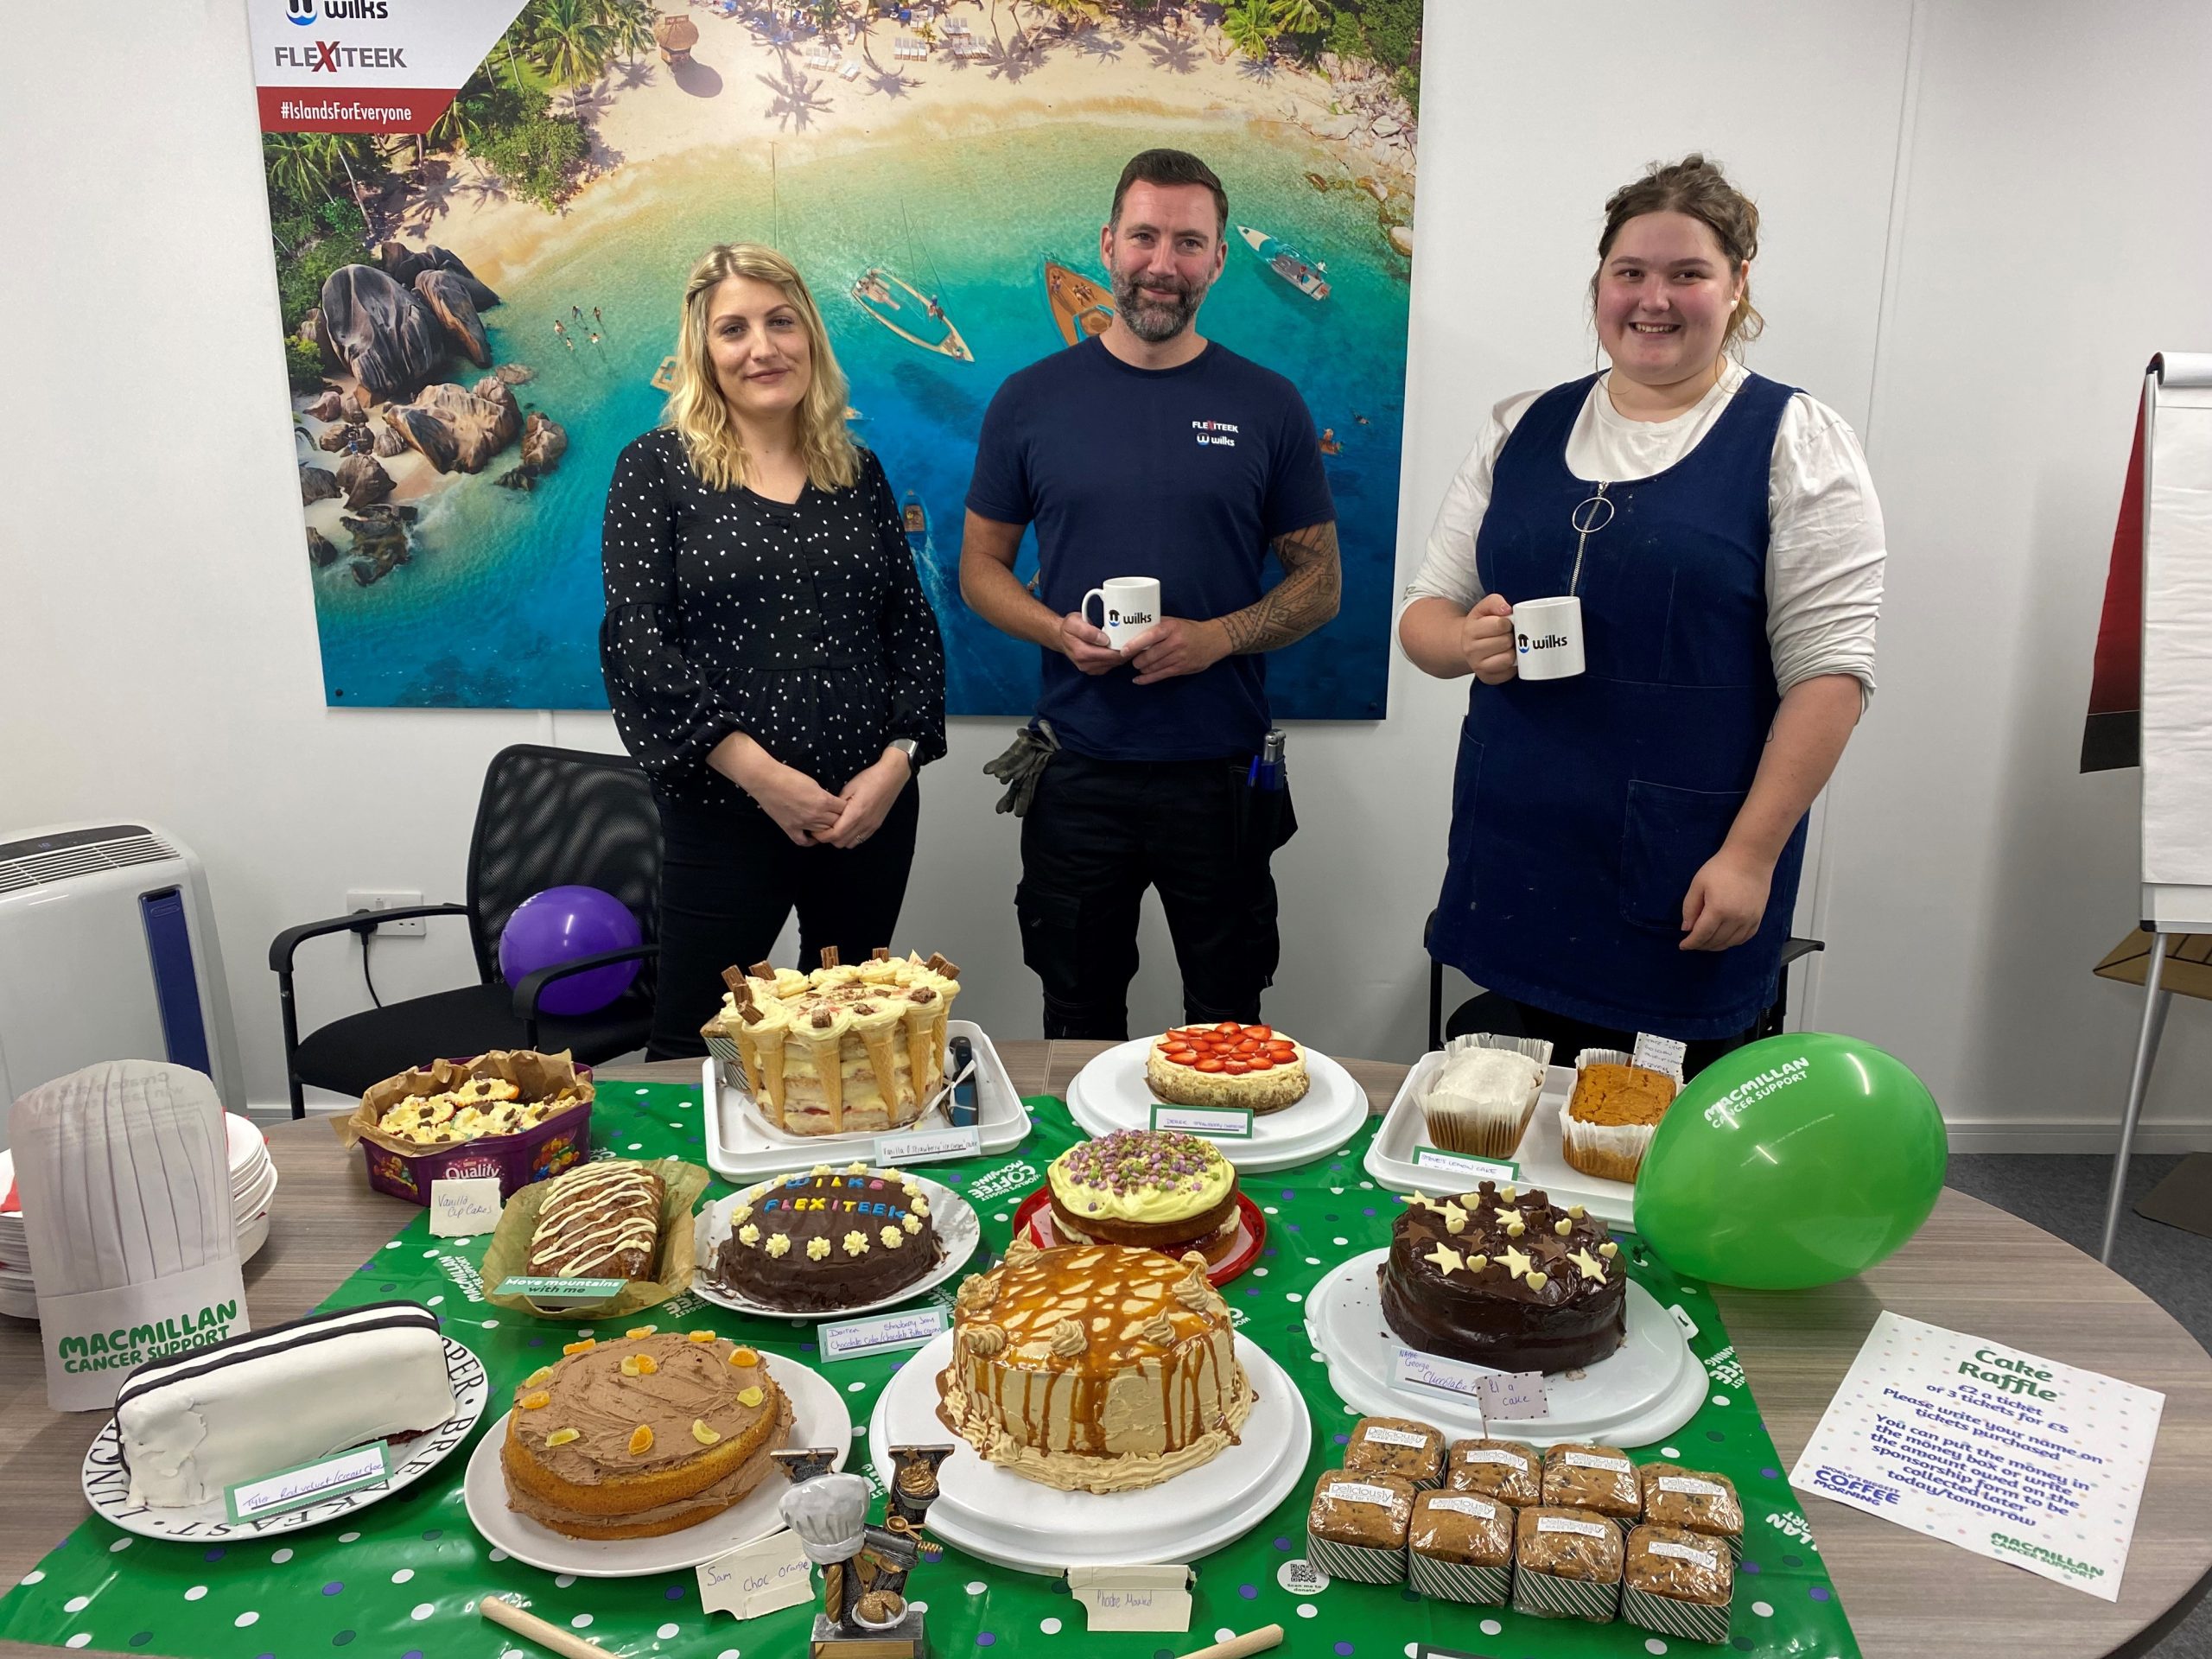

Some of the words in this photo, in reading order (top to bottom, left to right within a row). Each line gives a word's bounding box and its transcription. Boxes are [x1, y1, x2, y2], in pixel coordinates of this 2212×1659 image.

[274, 41, 407, 73] FLEXITEEK
[281, 101, 412, 124] #IslandsForEveryone
[1192, 420, 1239, 433] FLEXITEEK
[1211, 435, 1235, 446] wilks
[1123, 612, 1152, 624] wilks
[1533, 634, 1567, 649] wilks
[1704, 1057, 1809, 1122] MACMILLAN
[1713, 1096, 1756, 1128] CANCER
[1755, 1070, 1808, 1100] SUPPORT
[446, 1164, 499, 1180] Quality
[968, 1165, 1035, 1198] COFFEE
[438, 1193, 468, 1207] Vanilla
[764, 1198, 906, 1220] FLEXITEEK
[546, 1279, 620, 1287] mountains
[59, 1300, 237, 1360] MACMILLAN
[64, 1350, 143, 1374] CANCER
[147, 1325, 230, 1361] SUPPORT
[1399, 1350, 1419, 1358] NAME
[1405, 1358, 1430, 1372] George
[1958, 1361, 2058, 1403] Raffle
[1975, 1350, 2053, 1382] Cake
[1926, 1384, 1946, 1395] or
[1947, 1389, 1956, 1398] 3
[1961, 1395, 2015, 1417] tickets
[2017, 1412, 2044, 1426] for
[2047, 1422, 2069, 1434] £5
[1958, 1384, 1979, 1396] £2
[1982, 1391, 1993, 1400] a
[1996, 1395, 2043, 1417] ticket
[1368, 1427, 1426, 1443] Deliciously
[1884, 1388, 1934, 1410] Please
[1937, 1407, 1982, 1426] write
[1986, 1421, 2025, 1440] your
[2029, 1436, 2077, 1457] name
[2081, 1452, 2103, 1465] on
[1915, 1407, 1970, 1431] tickets
[1972, 1427, 2061, 1461] purchased
[1567, 1453, 1628, 1469] Deliciously
[1875, 1424, 1903, 1440] the
[1905, 1435, 1962, 1461] money
[1967, 1453, 1998, 1471] box
[2001, 1468, 2022, 1478] or
[2024, 1475, 2072, 1497] write
[1877, 1414, 1906, 1431] You
[1910, 1427, 1939, 1441] can
[1942, 1438, 1973, 1452] put
[1977, 1448, 2005, 1463] the
[2008, 1459, 2068, 1486] money
[2072, 1478, 2089, 1491] in
[1662, 1478, 1722, 1493] Deliciously
[1815, 1470, 1901, 1505] COFFEE
[1821, 1465, 1862, 1481] WORLD'S
[1870, 1433, 1897, 1448] the
[1901, 1445, 1968, 1471] amount
[1970, 1469, 2018, 1489] owed
[2022, 1485, 2046, 1498] on
[2049, 1493, 2081, 1510] the
[1872, 1445, 1973, 1484] sponsorship
[1975, 1478, 2020, 1500] form
[2024, 1495, 2043, 1507] to
[2047, 1502, 2069, 1516] be
[280, 1487, 297, 1498] Red
[1331, 1484, 1392, 1502] Deliciously
[1814, 1479, 1880, 1505] MORNING
[1887, 1470, 2036, 1526] today/tomorrow
[1903, 1465, 1980, 1497] collected
[1982, 1491, 2028, 1512] later
[1433, 1498, 1494, 1515] Deliciously
[1541, 1519, 1604, 1533] Deliciously
[1991, 1533, 2105, 1576] MACMILLAN
[1991, 1540, 2037, 1559] CANCER
[2040, 1557, 2096, 1580] SUPPORT
[707, 1566, 732, 1586] Sam
[743, 1574, 769, 1592] Choc
[778, 1560, 809, 1578] Orange
